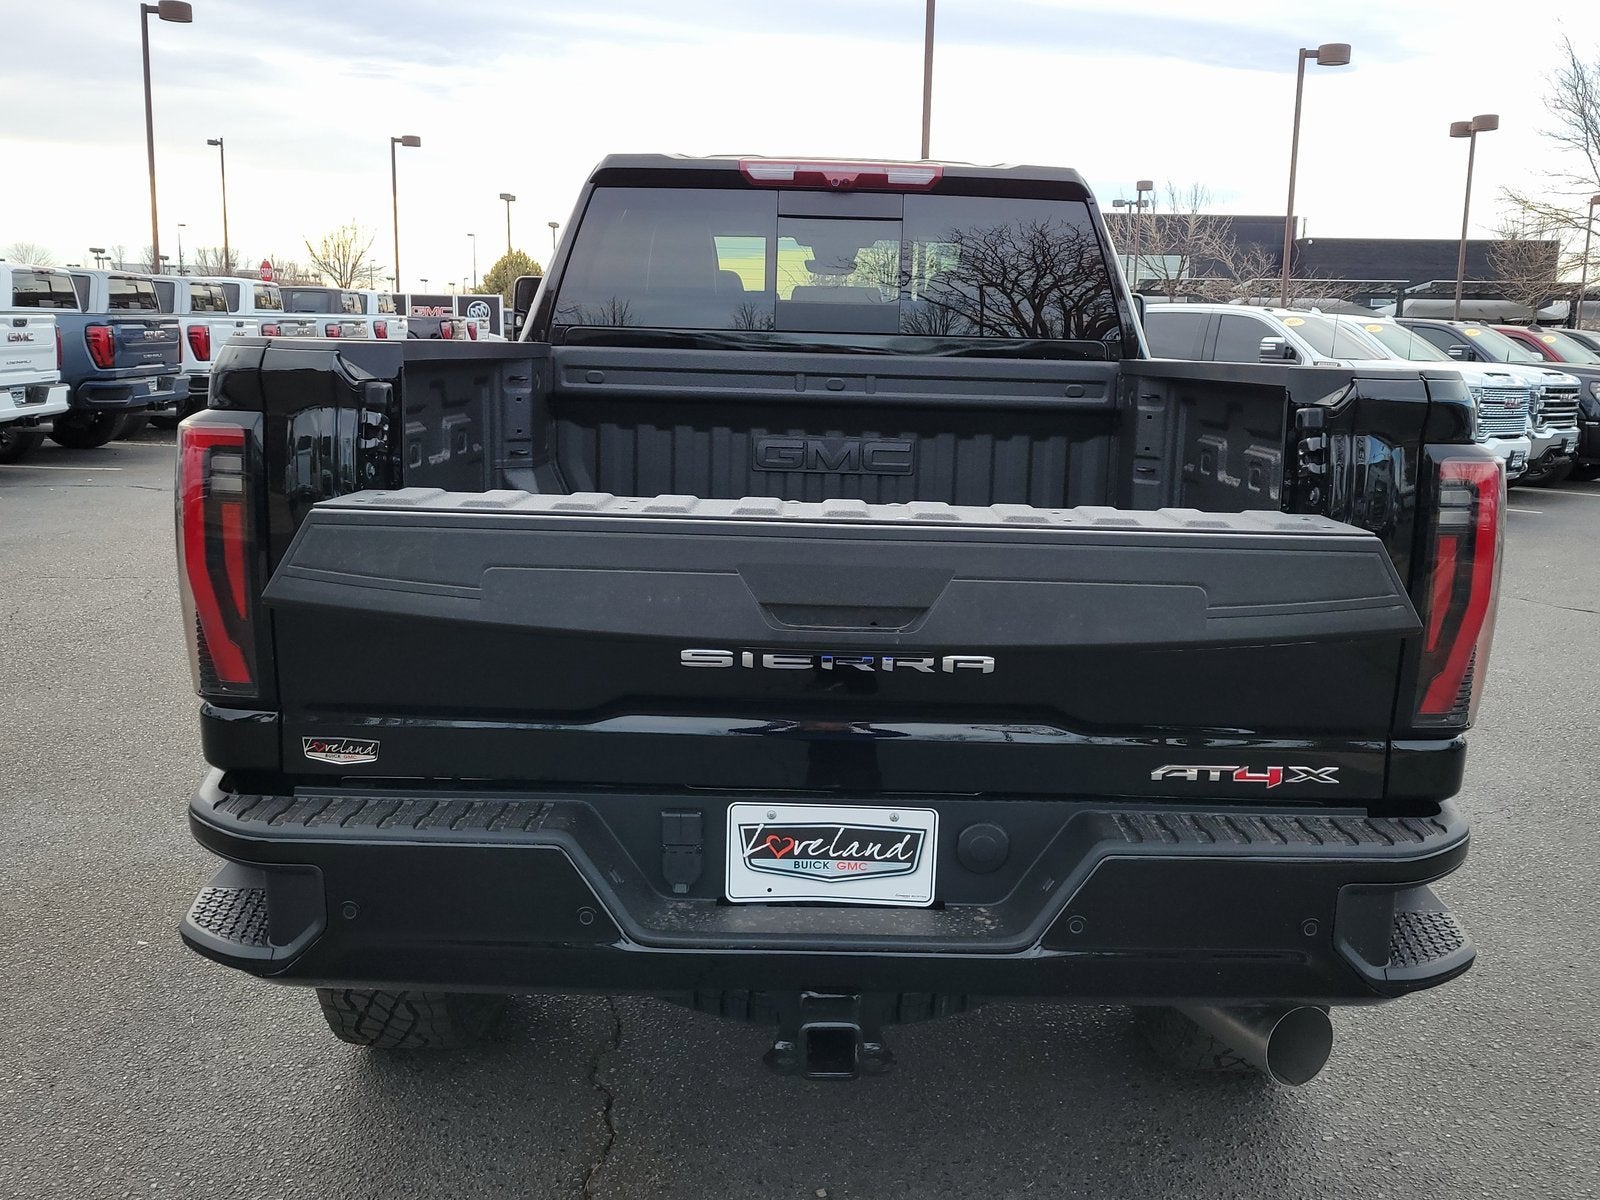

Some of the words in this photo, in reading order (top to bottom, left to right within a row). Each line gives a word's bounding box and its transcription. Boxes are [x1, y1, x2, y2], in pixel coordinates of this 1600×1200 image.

[261, 268, 272, 278] STOP
[411, 306, 454, 316] GMC
[8, 333, 35, 342] GMC
[757, 439, 911, 471] GMC
[680, 648, 995, 674] SIERRA
[1151, 765, 1340, 788] AT4X
[793, 860, 830, 870] BUICK
[836, 861, 868, 871] GMC
